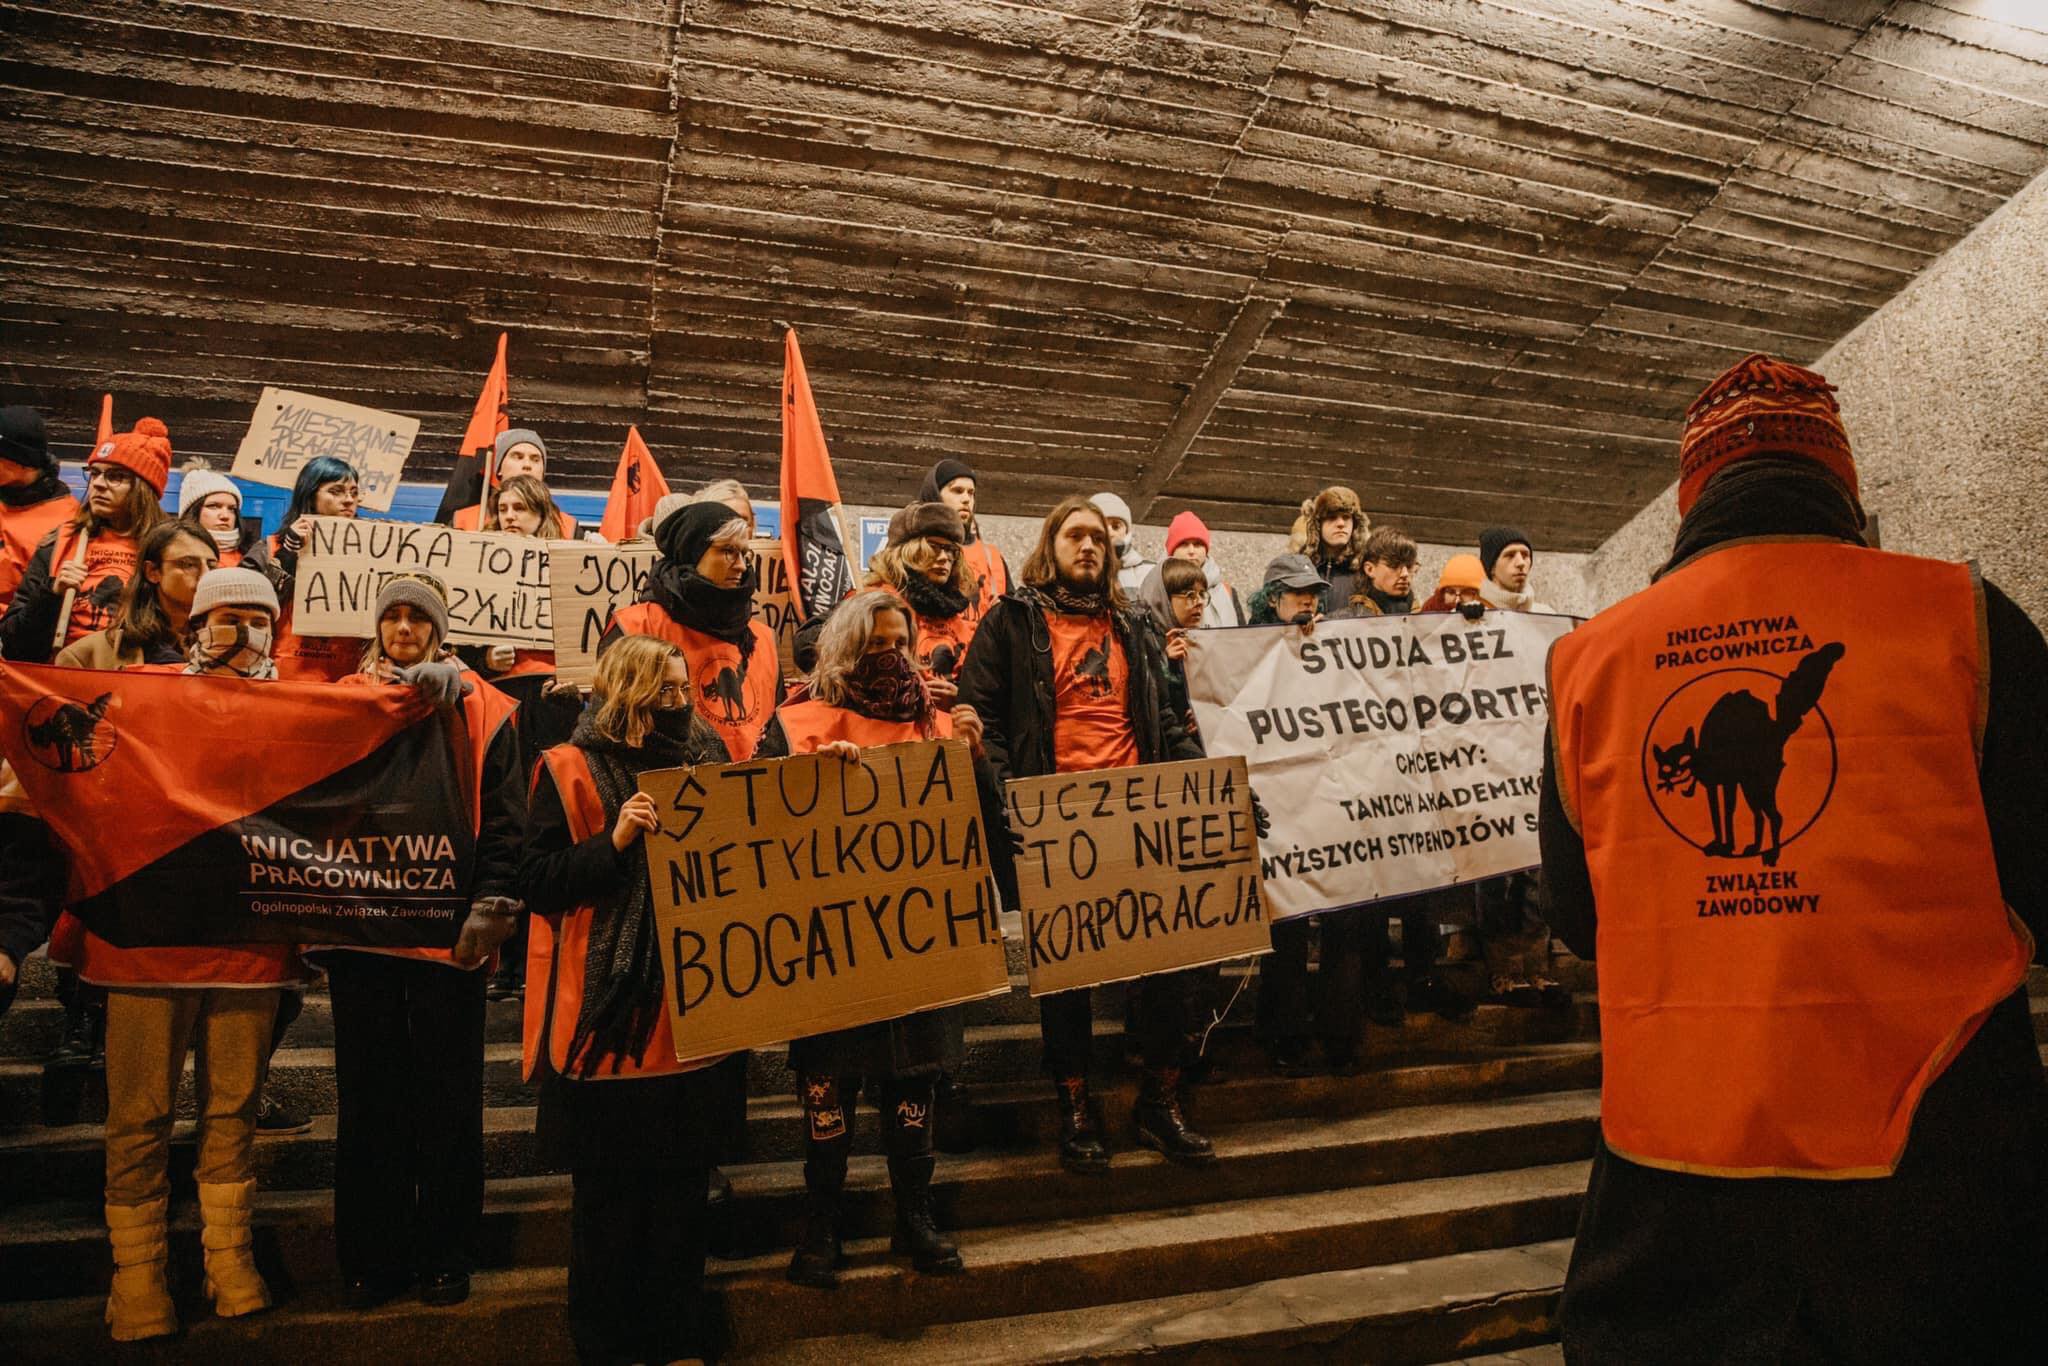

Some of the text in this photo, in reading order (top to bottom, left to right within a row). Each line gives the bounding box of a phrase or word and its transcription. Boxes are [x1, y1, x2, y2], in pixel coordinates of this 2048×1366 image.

[273, 404, 410, 456] MIESZKANIE
[260, 446, 304, 470] NIE
[311, 519, 453, 568] NAUKA
[469, 540, 513, 575] TO
[1666, 615, 1799, 647] INICJATYWA
[1300, 628, 1515, 675] STUDIA BEZ
[1655, 634, 1814, 669] PRACOWNICZA
[1246, 697, 1408, 745] PUSTEGO
[1395, 744, 1489, 775] CHCEMY:
[663, 745, 954, 842] STUDIA
[1011, 768, 1236, 828] UCZELNIA
[1339, 793, 1415, 822] TANICH
[241, 835, 456, 864] INICJATYWA
[1027, 810, 1250, 889] TO NIEEE
[1387, 815, 1516, 858] STYPENDIÓW
[250, 862, 456, 890] PRACOWNICZA
[1706, 871, 1798, 896] ZWIĄZEK
[251, 900, 455, 920] Ogólnopolski Związek Zawodowy
[1027, 874, 1261, 969] KORPORACJA
[1697, 895, 1821, 917] ZAWODOWY
[673, 875, 998, 1017] BOGATYCH!
